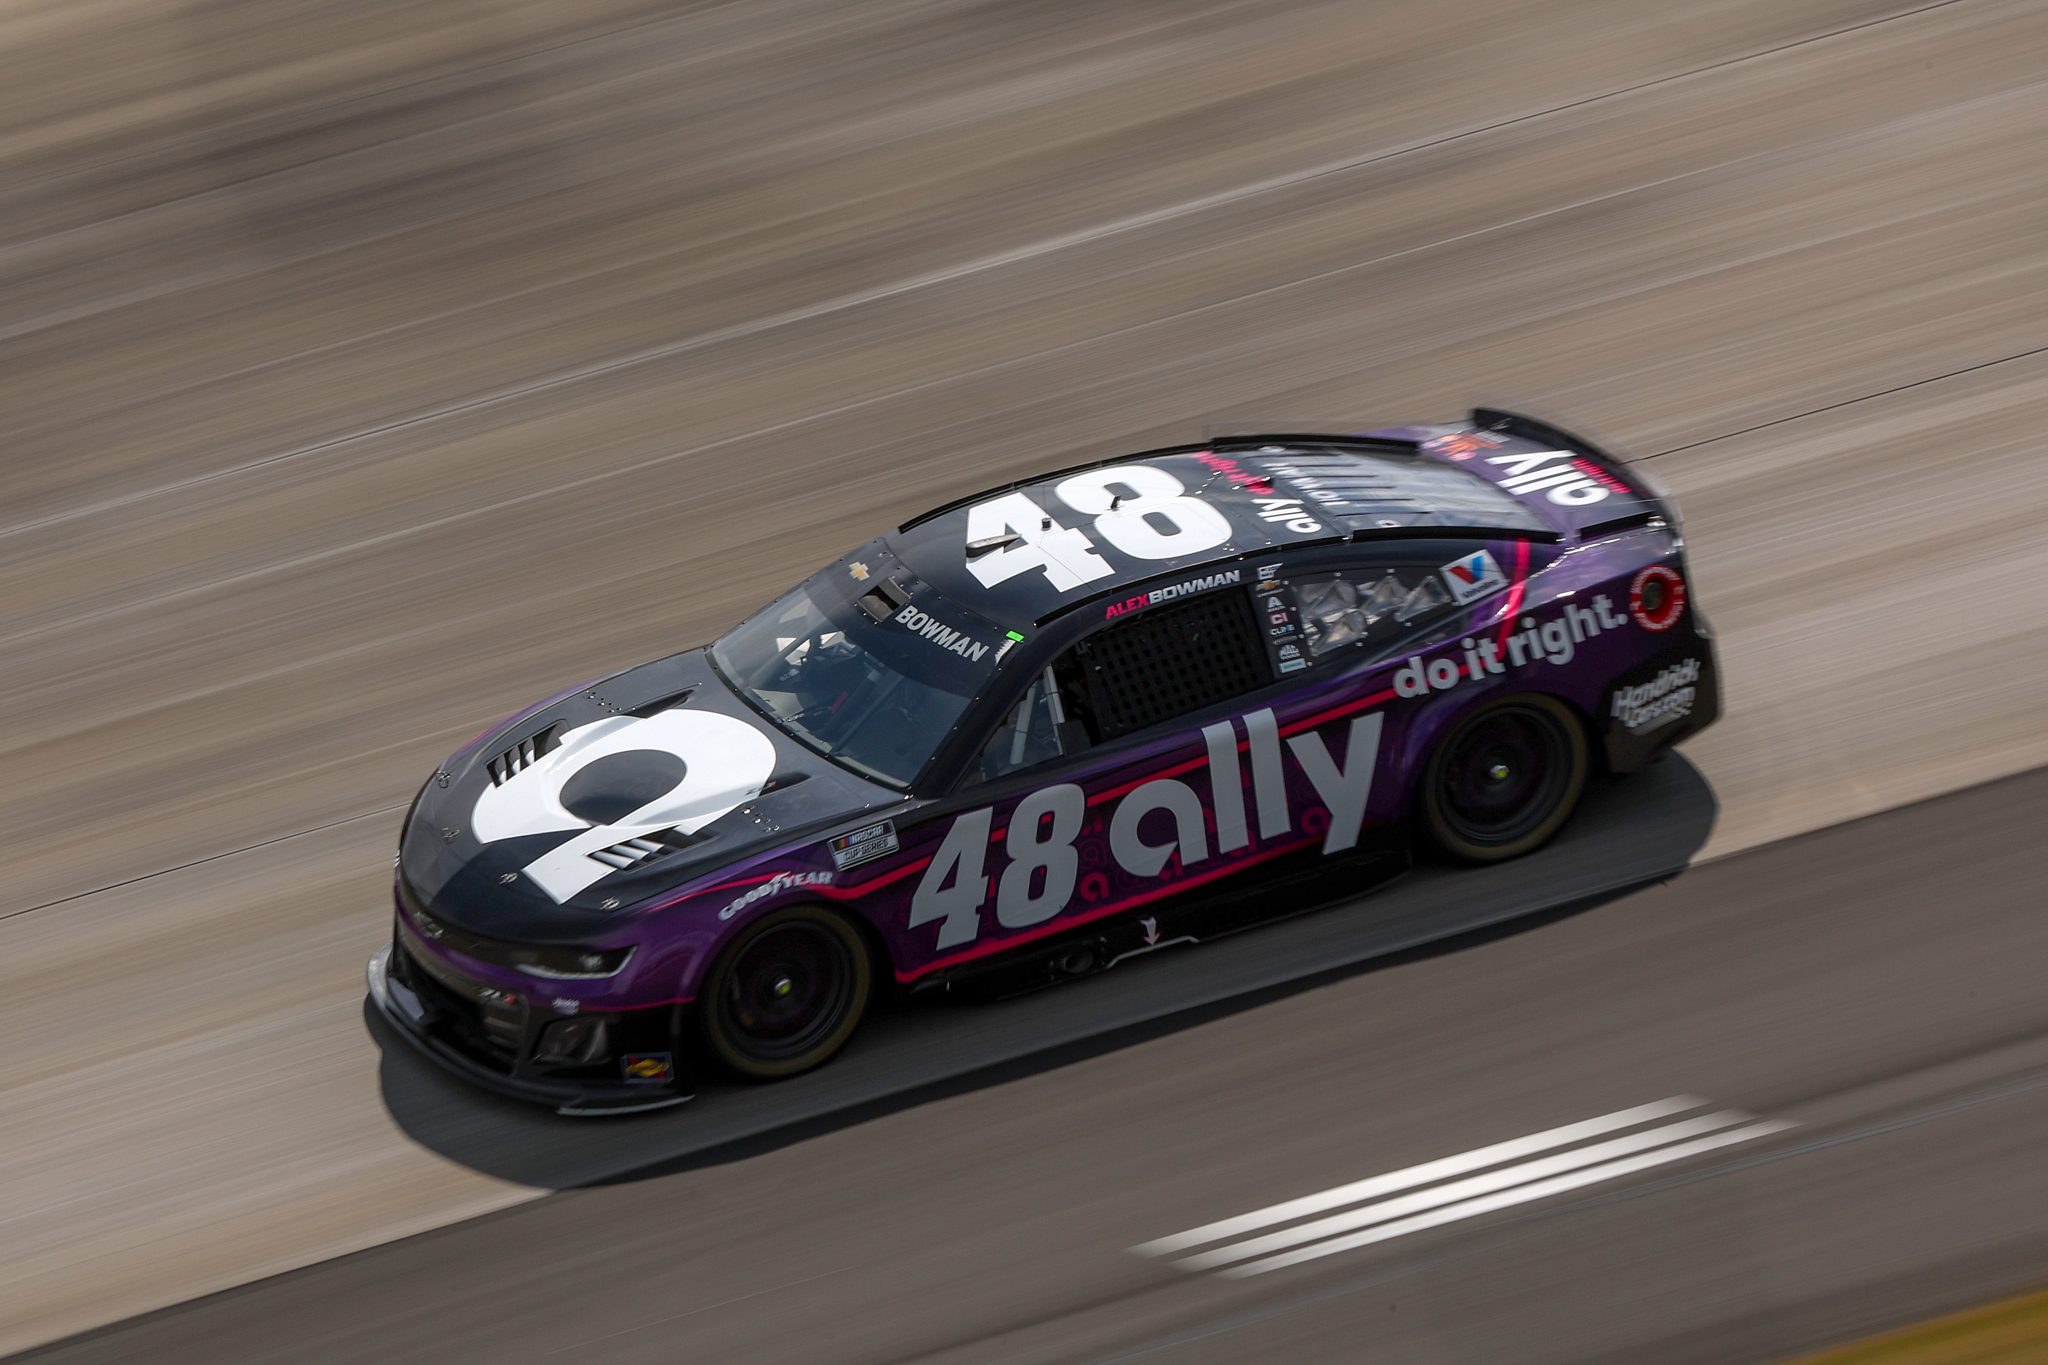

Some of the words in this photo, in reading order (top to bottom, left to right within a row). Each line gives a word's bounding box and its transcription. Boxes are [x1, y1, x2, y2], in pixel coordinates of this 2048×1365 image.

[1484, 449, 1610, 506] ally
[965, 465, 1233, 593] 48
[1251, 498, 1322, 533] ally
[895, 604, 990, 663] BOWMAN
[1392, 654, 1460, 698] do
[1461, 636, 1506, 681] it
[1507, 594, 1629, 665] right.
[1108, 707, 1384, 877] ally
[844, 847, 860, 861] CUP
[861, 838, 889, 855] SERIES
[907, 783, 1085, 951] 48
[717, 871, 834, 921] GOODYEAR
